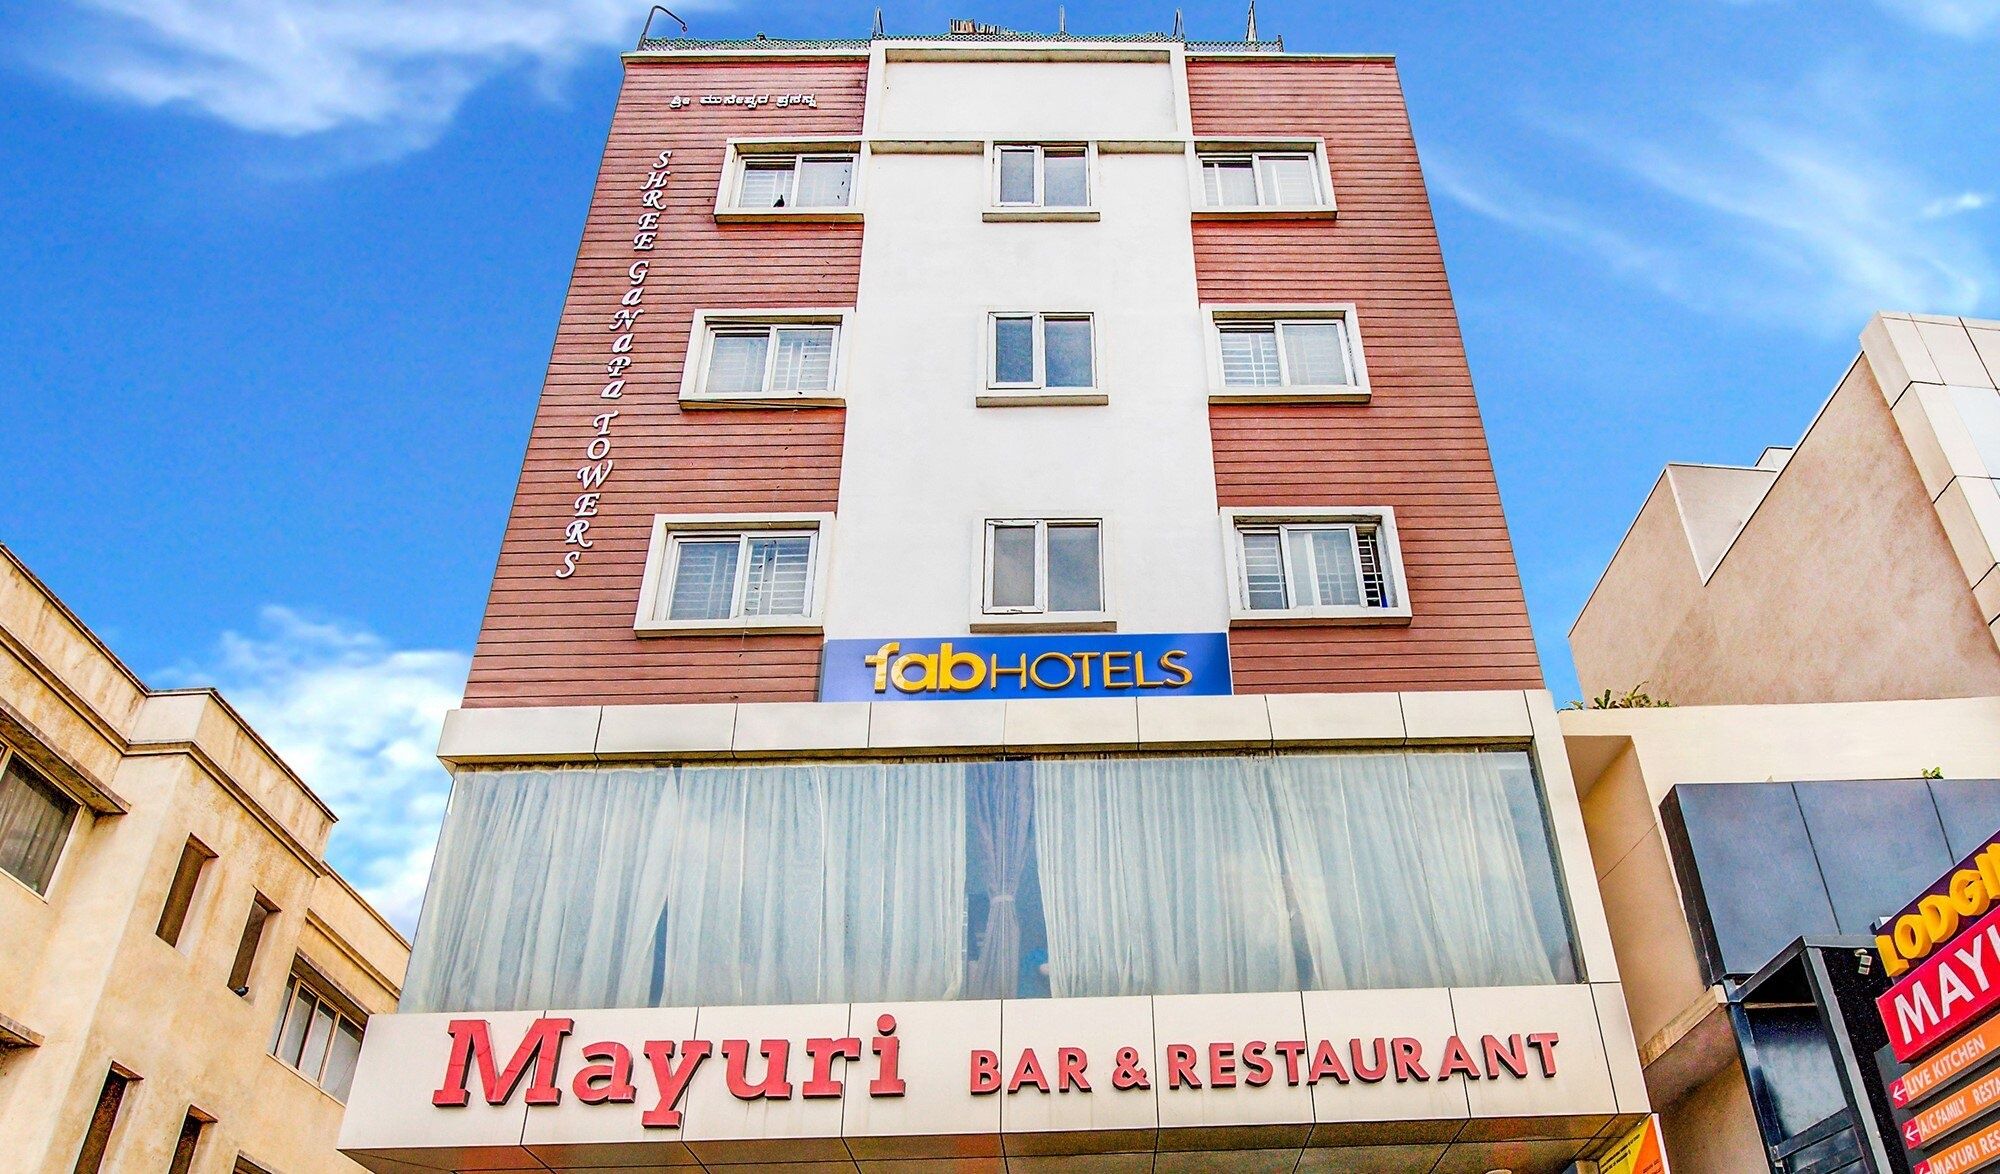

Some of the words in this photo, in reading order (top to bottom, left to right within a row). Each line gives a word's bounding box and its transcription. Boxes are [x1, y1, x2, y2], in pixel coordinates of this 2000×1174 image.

[633, 149, 672, 252] SHREE
[555, 410, 619, 579] TOWERS
[431, 1013, 906, 1129] Mayuri
[969, 1047, 1093, 1095] BAR
[1111, 1046, 1151, 1091] &
[1167, 1032, 1561, 1090] RESTAURANT
[1906, 1068, 1932, 1095] LIVE
[1931, 1034, 1986, 1079] KITCHEN
[1932, 1142, 1979, 1174] MAYURI
